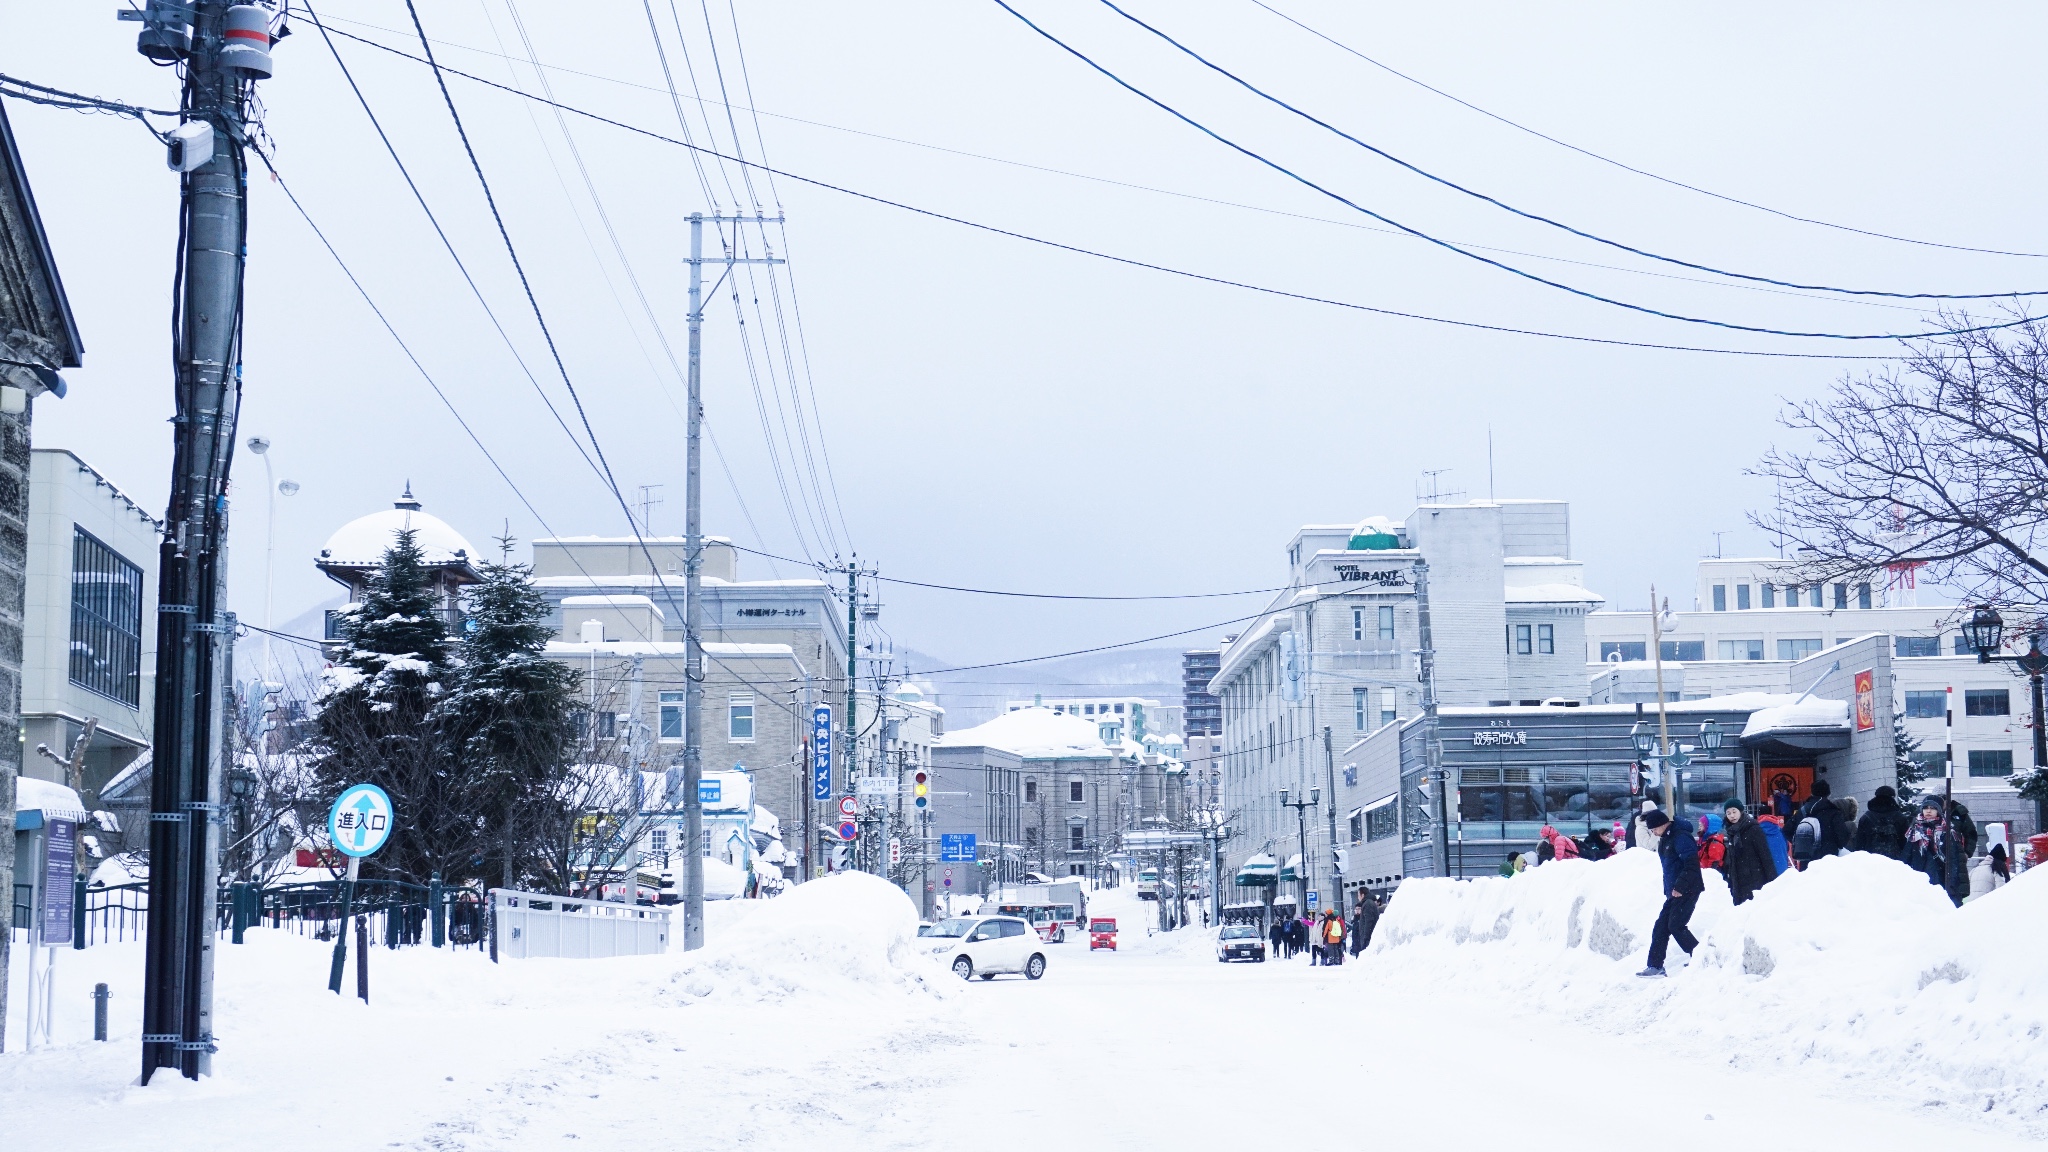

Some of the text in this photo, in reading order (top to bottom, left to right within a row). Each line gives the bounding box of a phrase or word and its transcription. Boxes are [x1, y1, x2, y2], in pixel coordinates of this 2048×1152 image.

[1340, 570, 1399, 581] VIBRANT
[736, 608, 806, 617] 小樽運河ターミナル
[816, 712, 829, 796] 中央ビルメン
[844, 802, 855, 810] 40
[337, 811, 386, 831] 進入口
[1306, 892, 1316, 901] P
